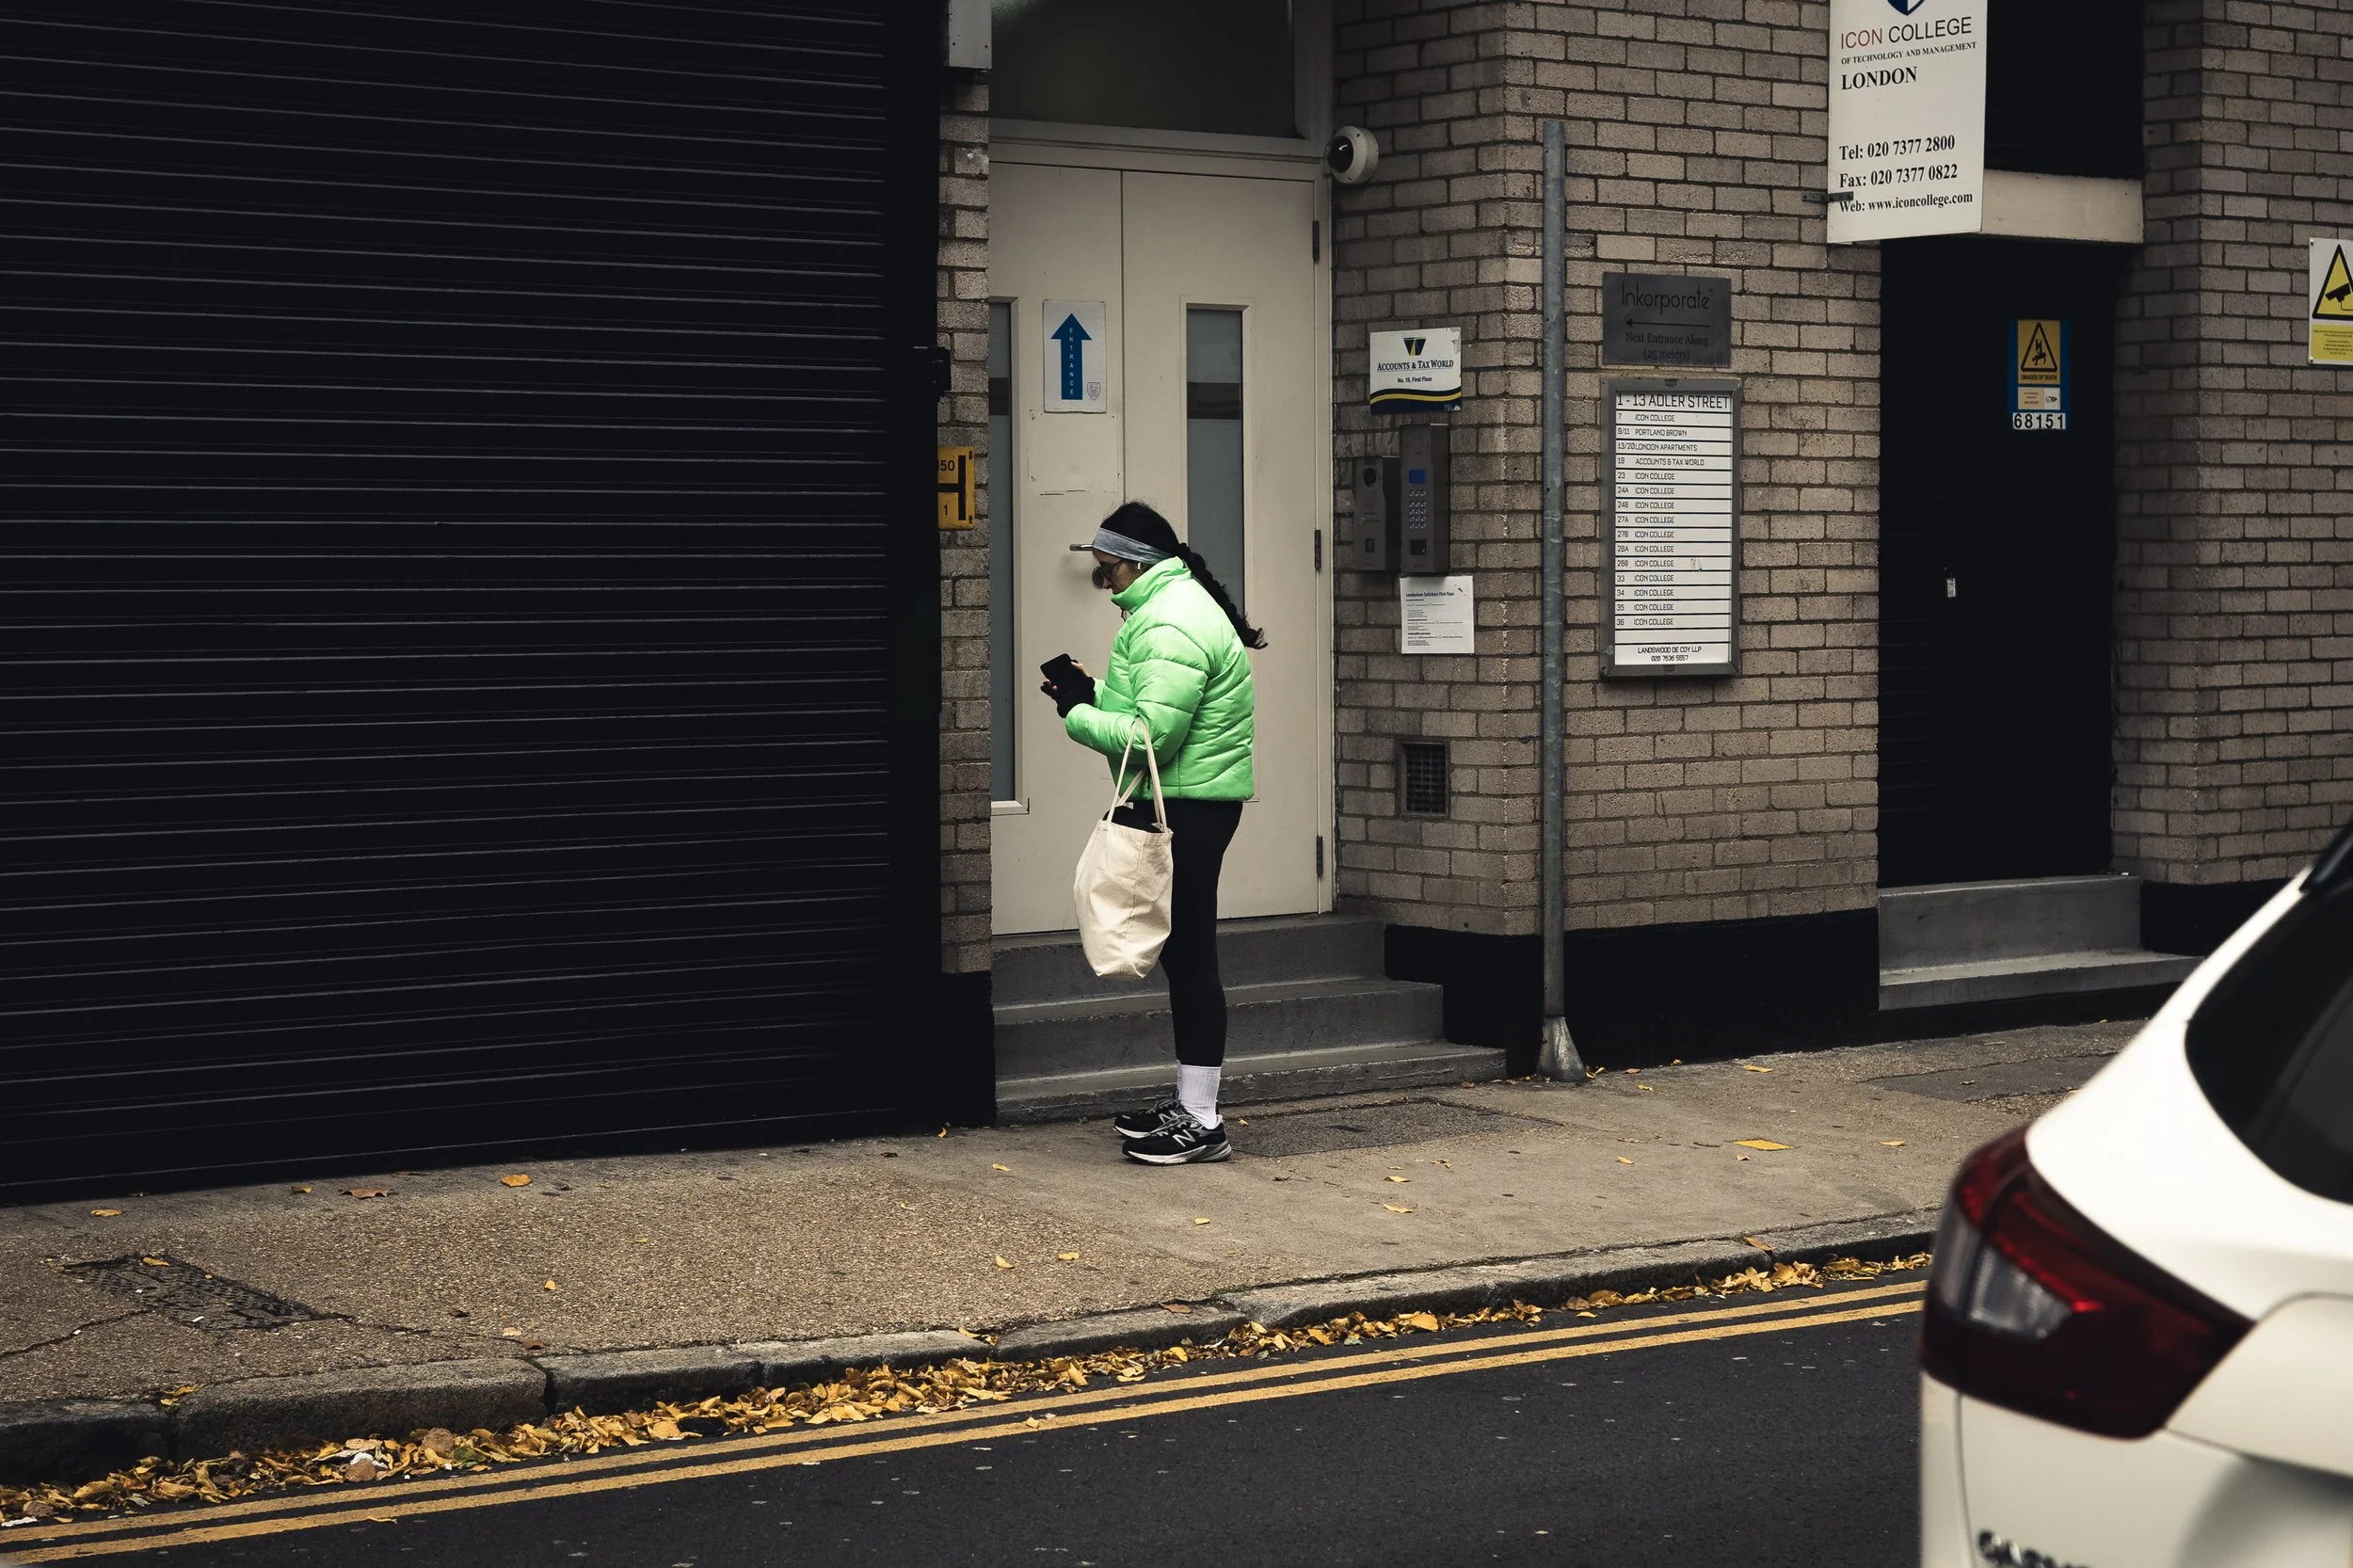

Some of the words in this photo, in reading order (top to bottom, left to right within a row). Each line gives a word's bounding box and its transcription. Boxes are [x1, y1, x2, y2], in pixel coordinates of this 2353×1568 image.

[1840, 28, 1882, 49] ICON
[1888, 17, 1972, 43] COLLEGE
[1841, 56, 1851, 65] OF
[1853, 51, 1904, 64] TECHNOLOGY
[1905, 48, 1921, 57] AND
[1922, 41, 1977, 56] MANAGEMENT
[1841, 66, 1918, 90] LONDON
[1839, 145, 1864, 160] Tel:
[1867, 142, 1889, 157] 020
[1893, 138, 1921, 155] 7377
[1926, 135, 1955, 152] 2800
[1839, 172, 1866, 187] Fax:
[1870, 170, 1892, 186] 020
[1897, 167, 1925, 184] 7377
[1929, 164, 1958, 181] 0822
[1839, 199, 1865, 213] Web:
[1868, 192, 1973, 211] www.iconcollege.com
[1622, 281, 1710, 314] Inkorporate
[1625, 331, 1644, 343] Next
[1647, 332, 1683, 344] Entrance
[1685, 333, 1709, 347] Along
[1377, 361, 1411, 371] ACCOUNTS
[1417, 360, 1430, 369] TAX
[1617, 394, 1624, 406] 1
[1633, 394, 1646, 407] 13
[1649, 394, 1685, 408] ADLER
[1688, 395, 1729, 408] STREET
[2014, 413, 2063, 429] 68151
[1660, 443, 1697, 452] APARTMENTS
[1635, 457, 1666, 466] ACCOUNTS
